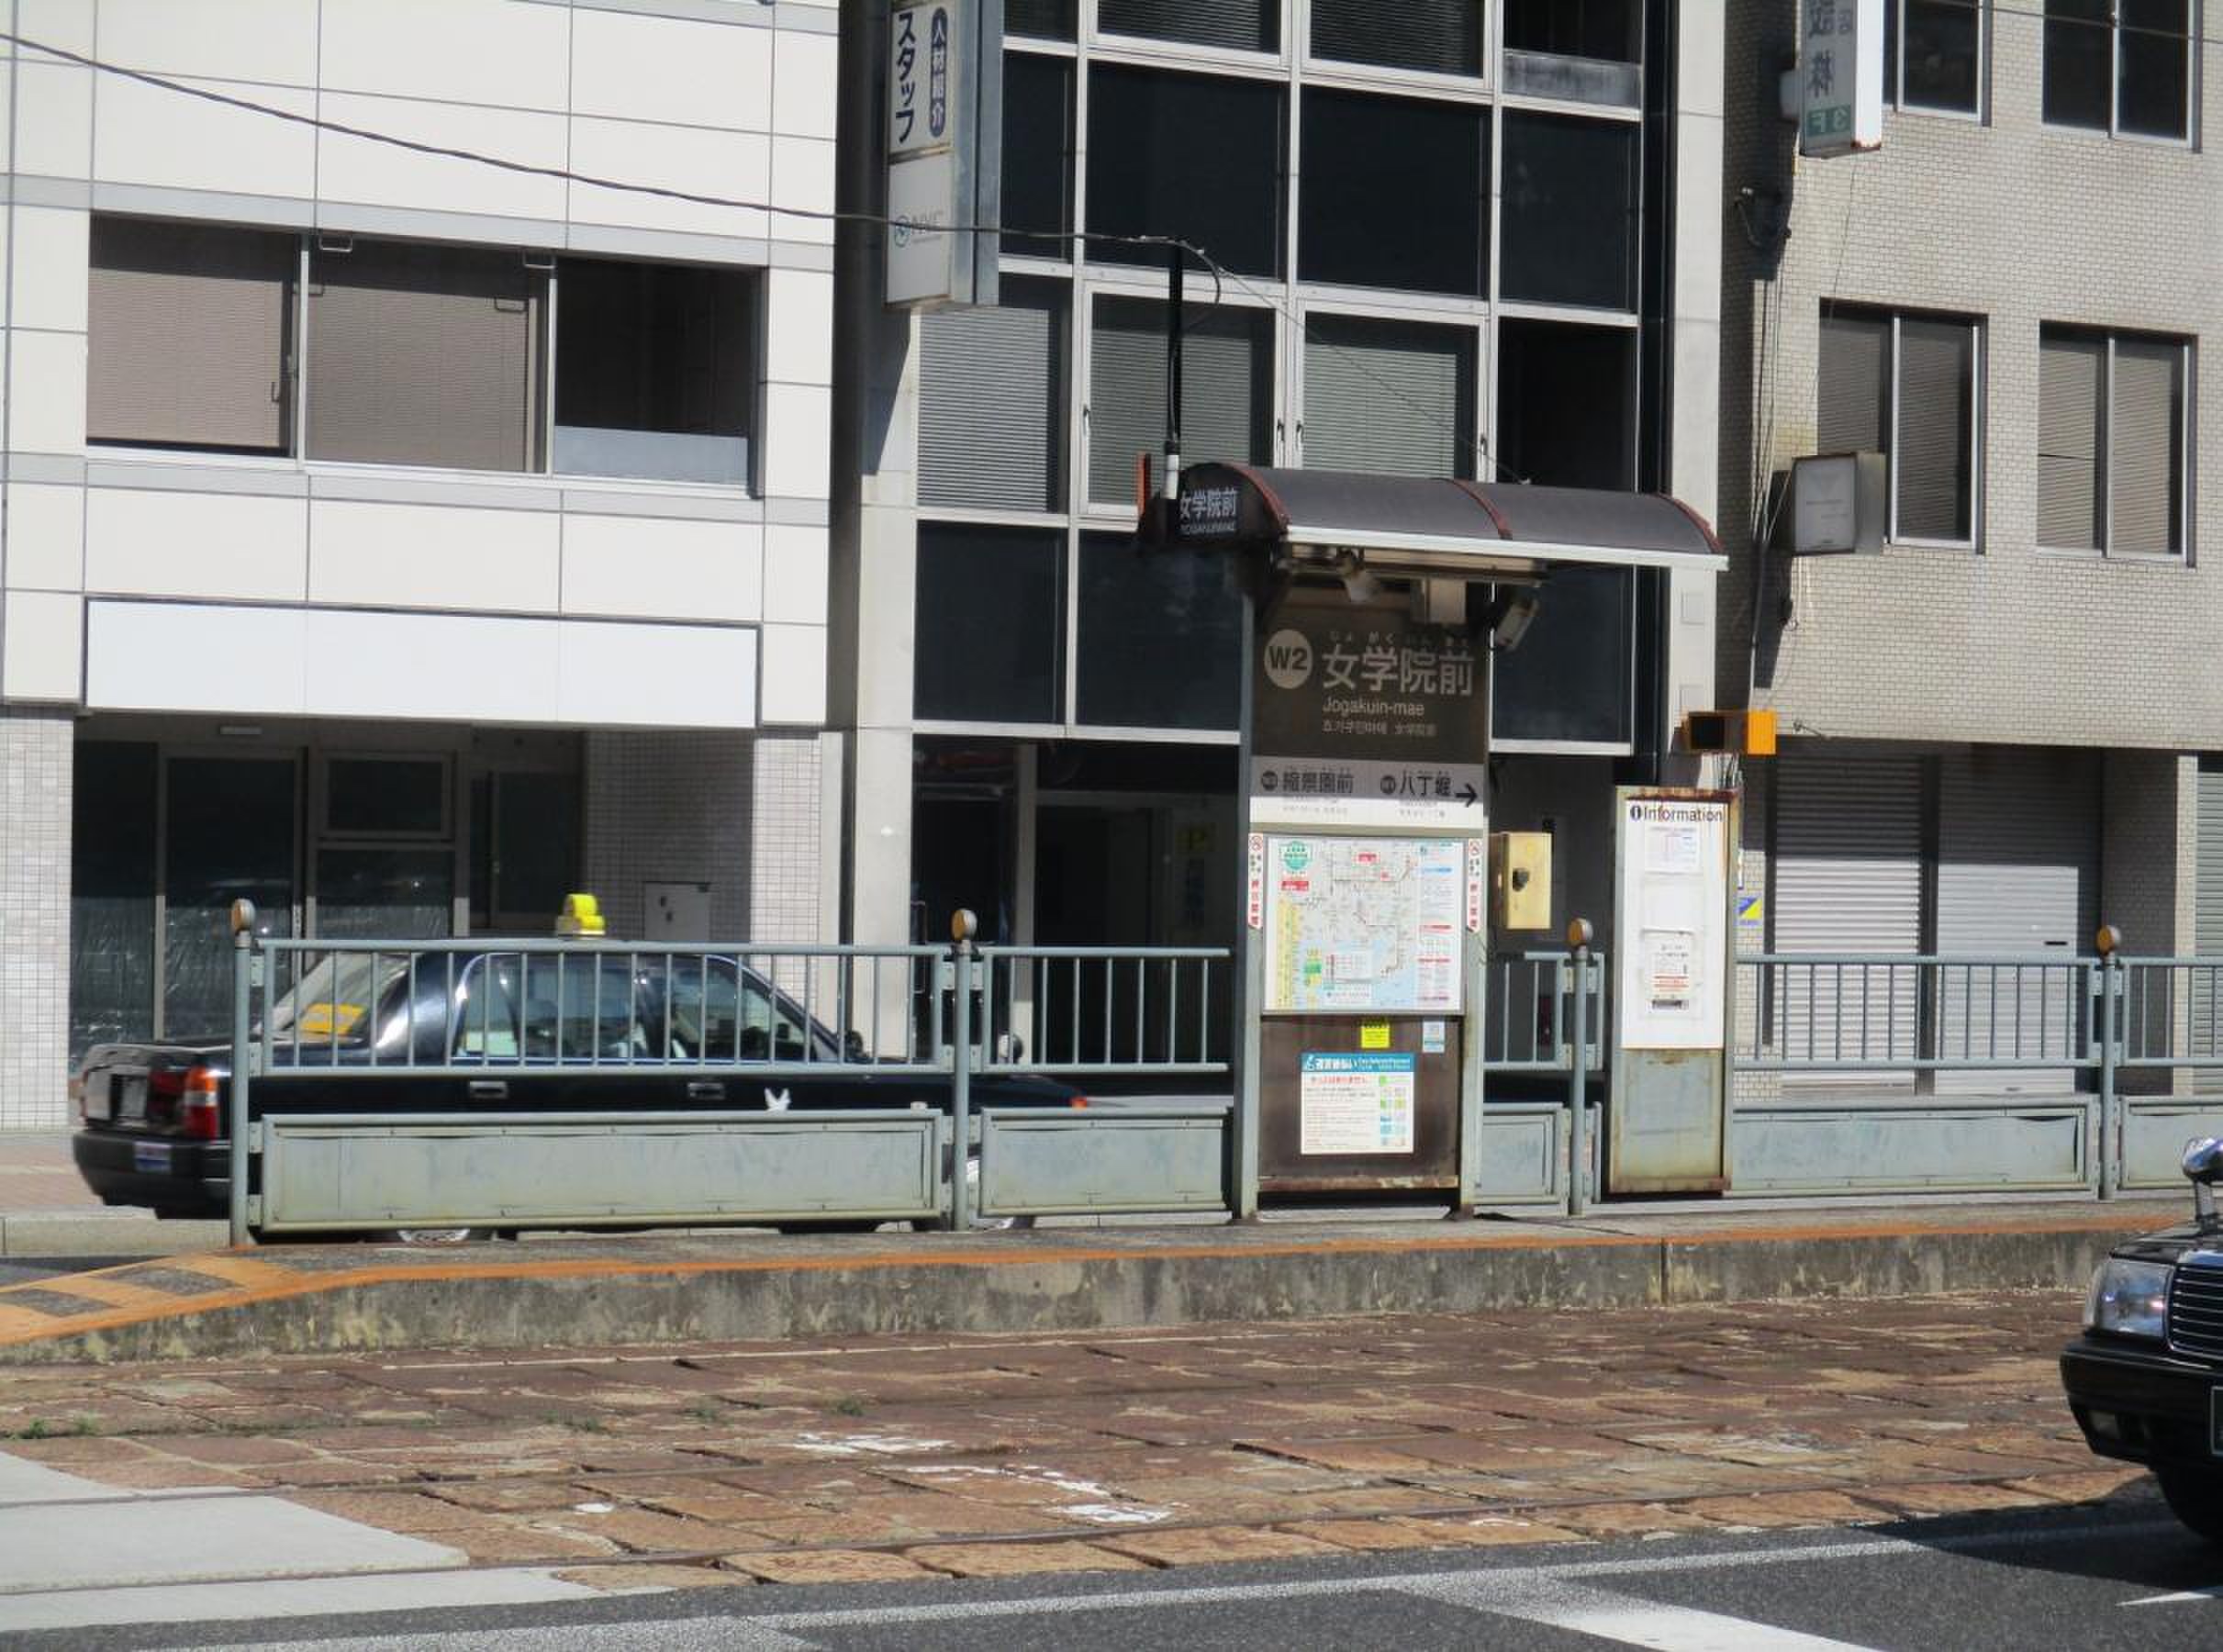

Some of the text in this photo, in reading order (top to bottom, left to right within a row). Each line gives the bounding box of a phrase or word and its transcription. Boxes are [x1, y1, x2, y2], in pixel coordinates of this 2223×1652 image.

[896, 11, 916, 143] スタッフ
[1268, 645, 1308, 671] W2
[1322, 644, 1476, 696] 女学院前
[1399, 770, 1452, 798] 八丁堀
[1643, 806, 1724, 823] Information
